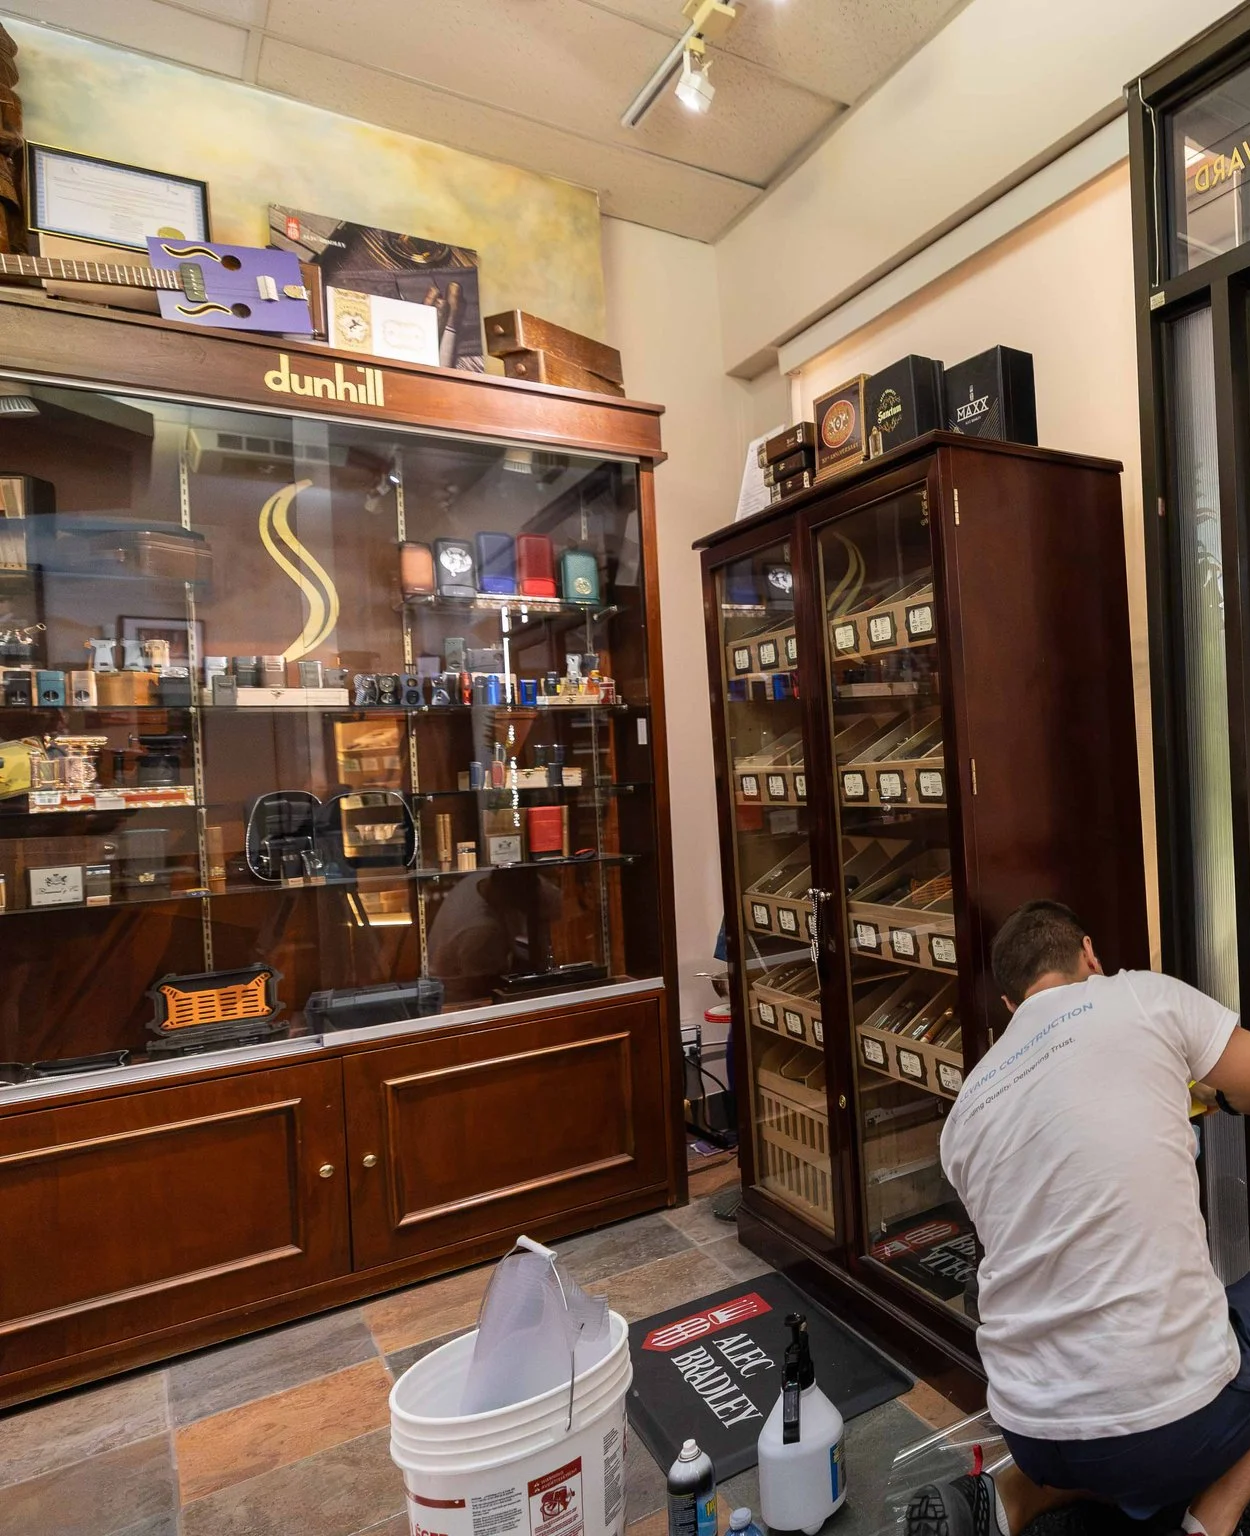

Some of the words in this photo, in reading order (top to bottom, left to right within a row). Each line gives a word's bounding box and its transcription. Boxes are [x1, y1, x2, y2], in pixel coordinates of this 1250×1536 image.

[264, 353, 384, 407] dunhill
[957, 395, 989, 422] MAXX
[1000, 1002, 1093, 1071] CONSTRUCTION
[1013, 1052, 1050, 1084] Delivering
[1050, 1037, 1076, 1054] Trust.
[711, 1332, 776, 1379] ALEC
[670, 1345, 764, 1429] BRADLEY
